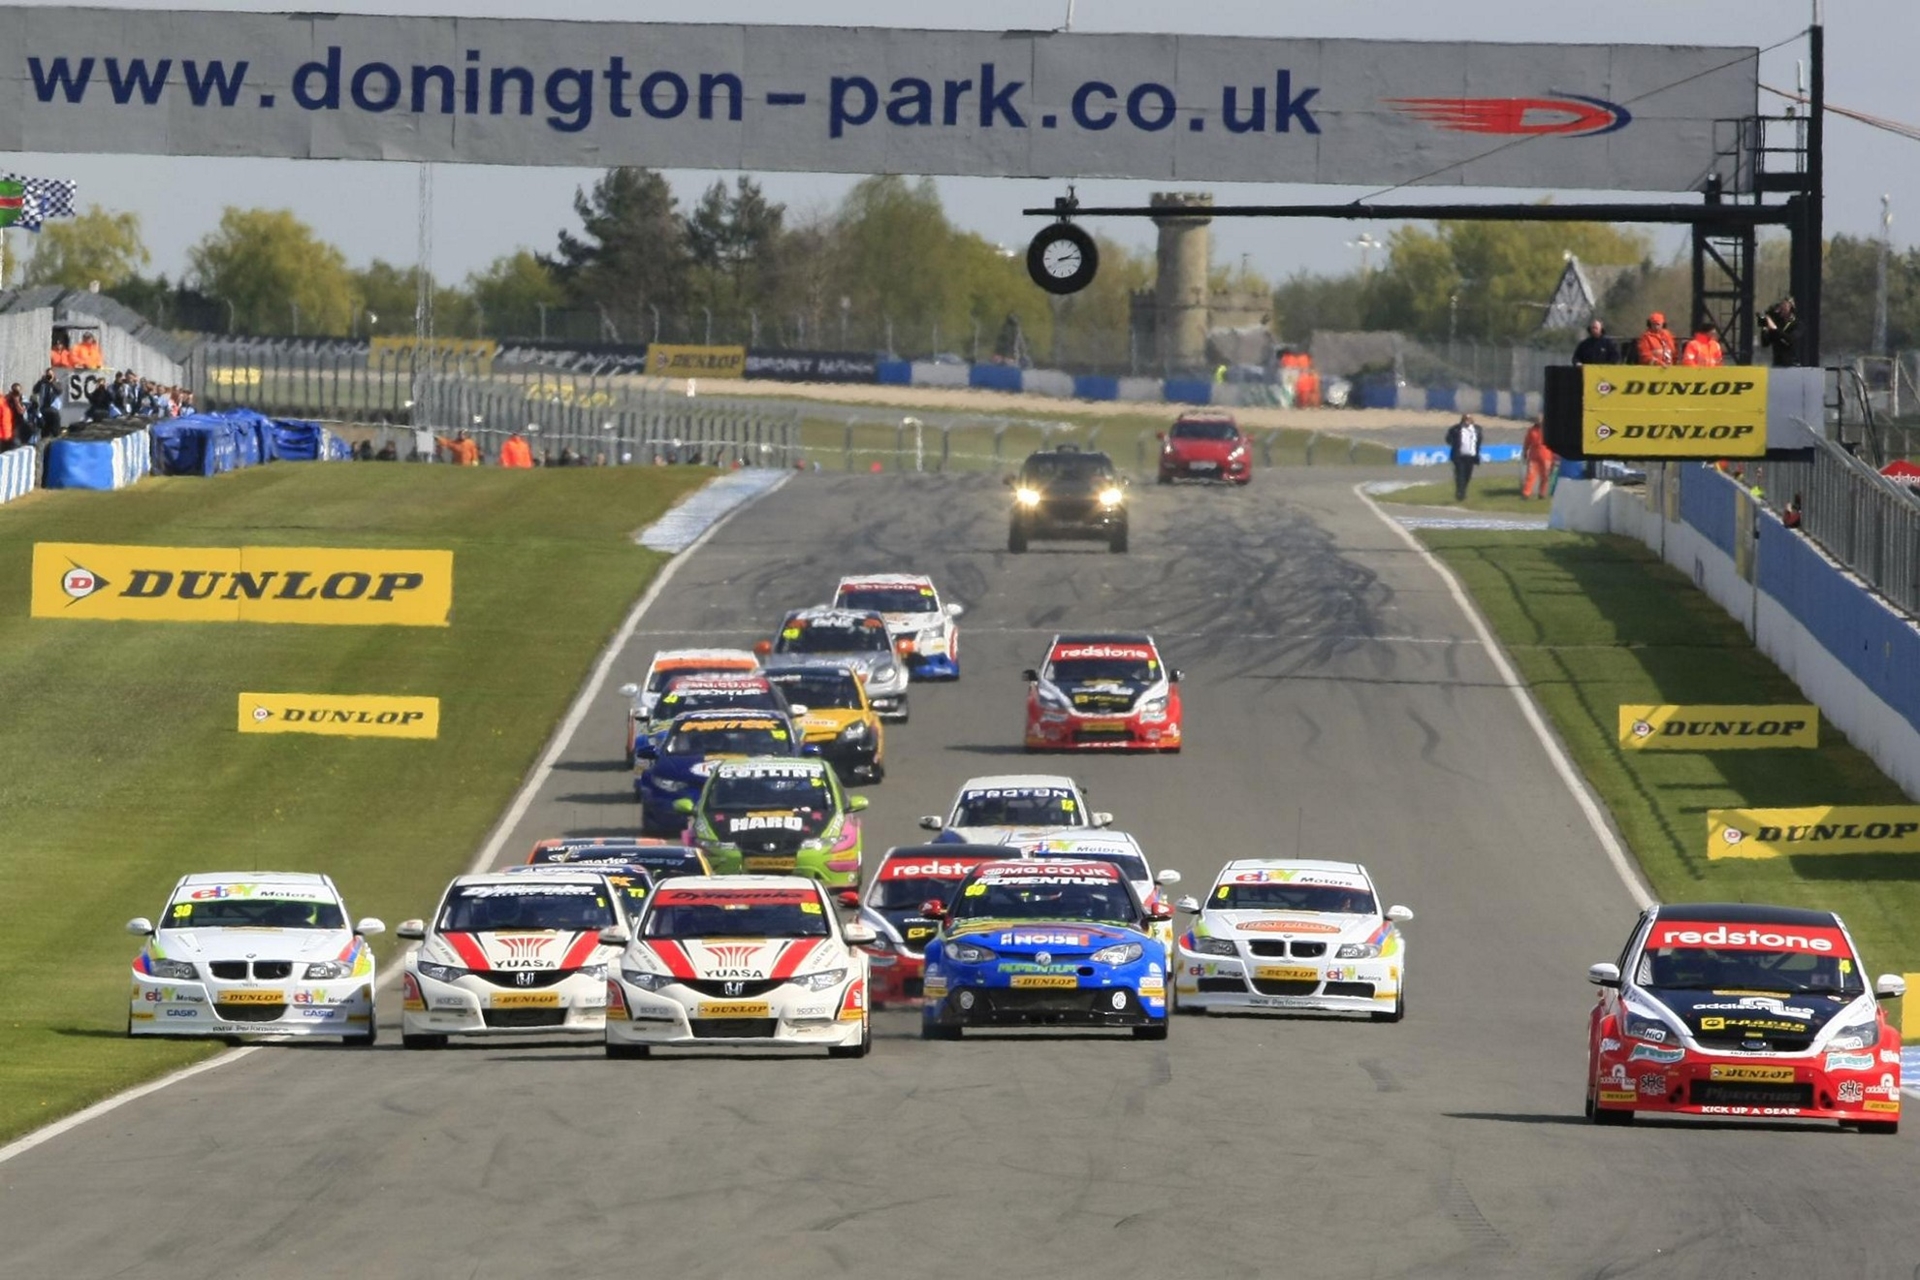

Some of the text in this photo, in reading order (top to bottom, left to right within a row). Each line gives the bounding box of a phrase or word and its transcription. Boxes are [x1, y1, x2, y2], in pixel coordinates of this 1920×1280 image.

[1621, 381, 1754, 396] DUNLOP
[1622, 425, 1754, 440] DUNLOP
[119, 570, 424, 601] DUNLOP
[1061, 646, 1148, 658] redstone
[280, 708, 423, 725] DUNLOP
[1660, 720, 1805, 737] DUNLOP
[967, 789, 1068, 800] PROTON
[730, 816, 803, 832] HARD
[1756, 822, 1919, 842] DUNLOP
[1300, 877, 1353, 887] Motors
[260, 891, 317, 899] Motors
[1664, 926, 1833, 951] redstone
[494, 959, 556, 969] YUASA
[704, 969, 765, 979] YUASA
[1266, 969, 1318, 978] DUNLOP
[1022, 978, 1076, 986] DUNLOP
[229, 993, 284, 1002] DUNLOP
[502, 995, 558, 1004] DUNLOP
[166, 1009, 198, 1017] CASIO
[303, 1009, 335, 1018] CASIO
[710, 1004, 768, 1014] DUNLOP
[1724, 1068, 1794, 1079] DUNLOP
[1701, 1105, 1729, 1113] KICK
[1731, 1106, 1748, 1114] UP
